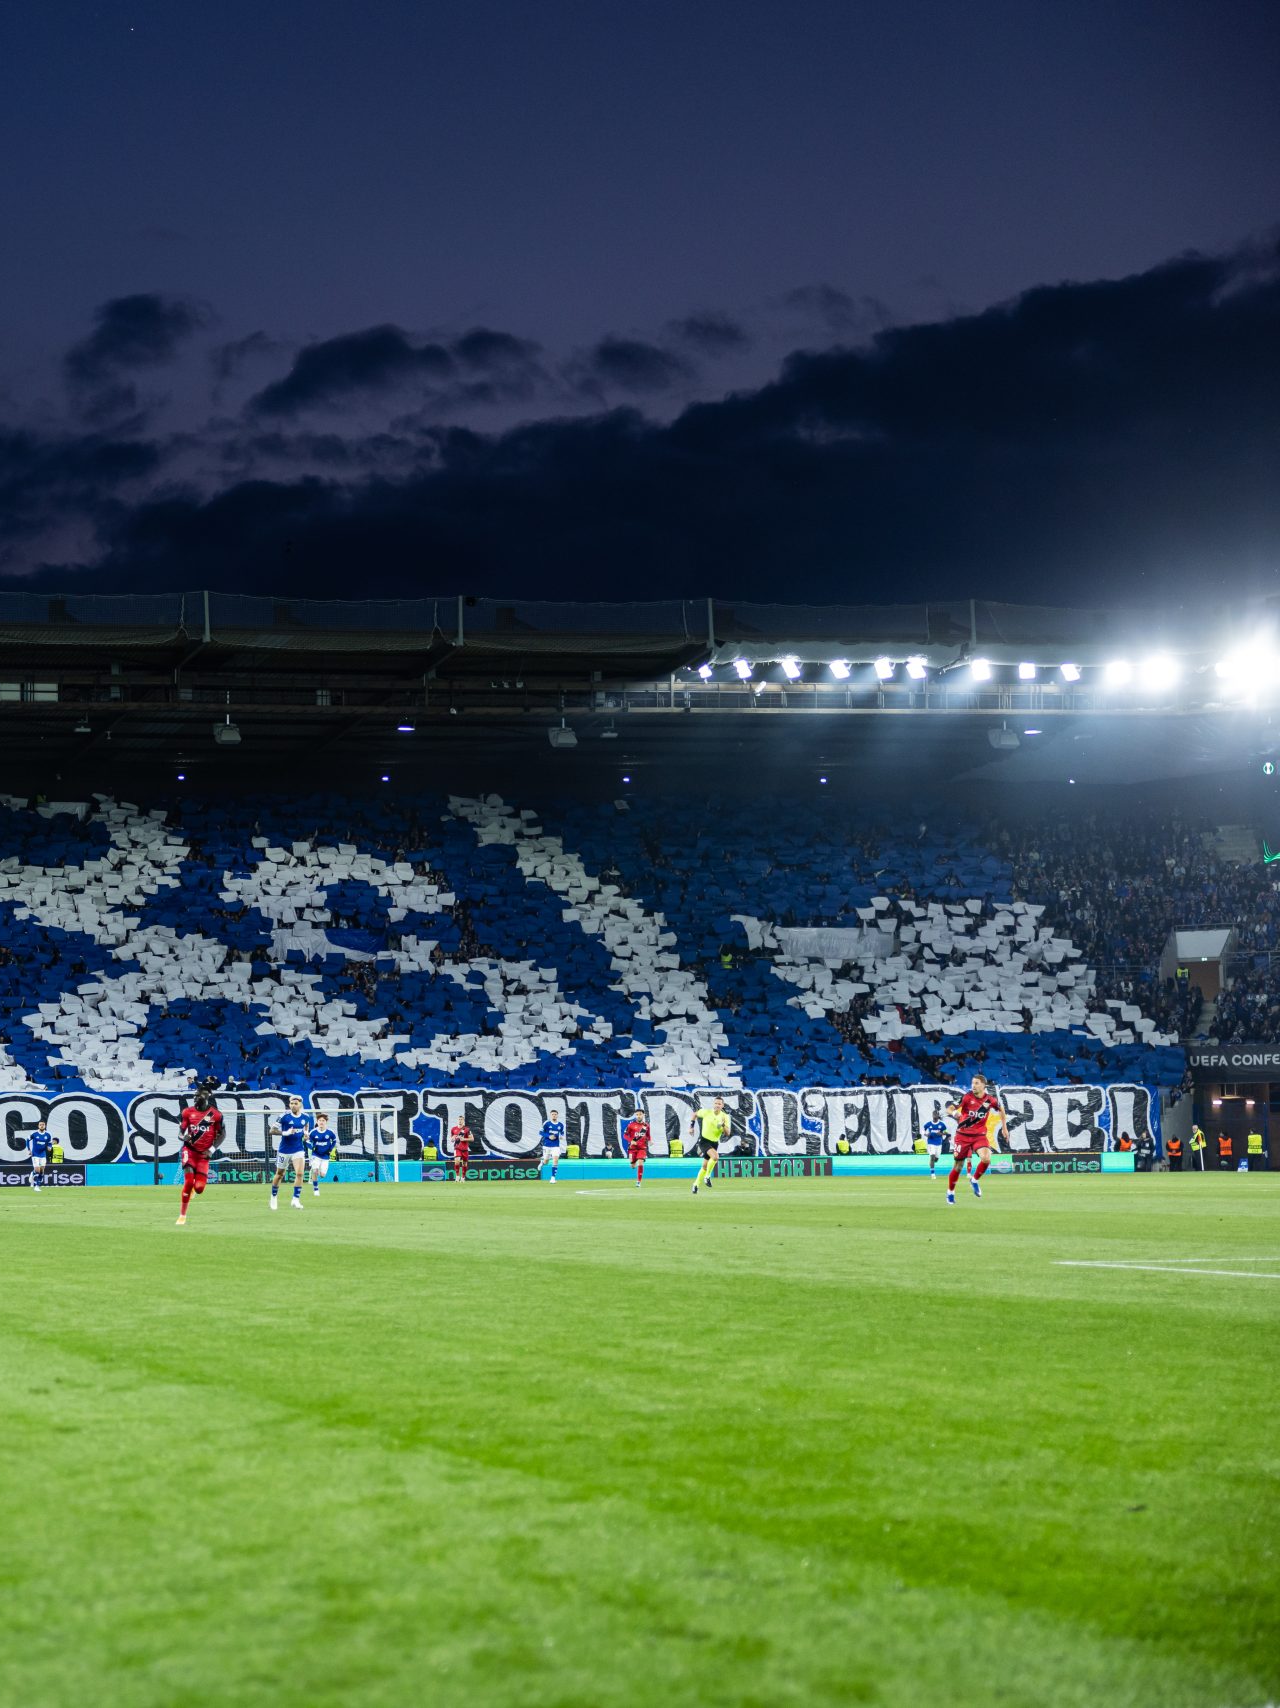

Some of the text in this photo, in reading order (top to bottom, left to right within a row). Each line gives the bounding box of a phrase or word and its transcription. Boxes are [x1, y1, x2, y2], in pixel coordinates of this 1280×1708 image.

[1190, 1055, 1228, 1067] UEFA
[759, 1087, 1097, 1154] L'EURPE
[968, 1110, 987, 1119] DIGI
[770, 1159, 805, 1178] FOR
[811, 1159, 828, 1177] IT
[997, 1158, 1100, 1173] enterprise
